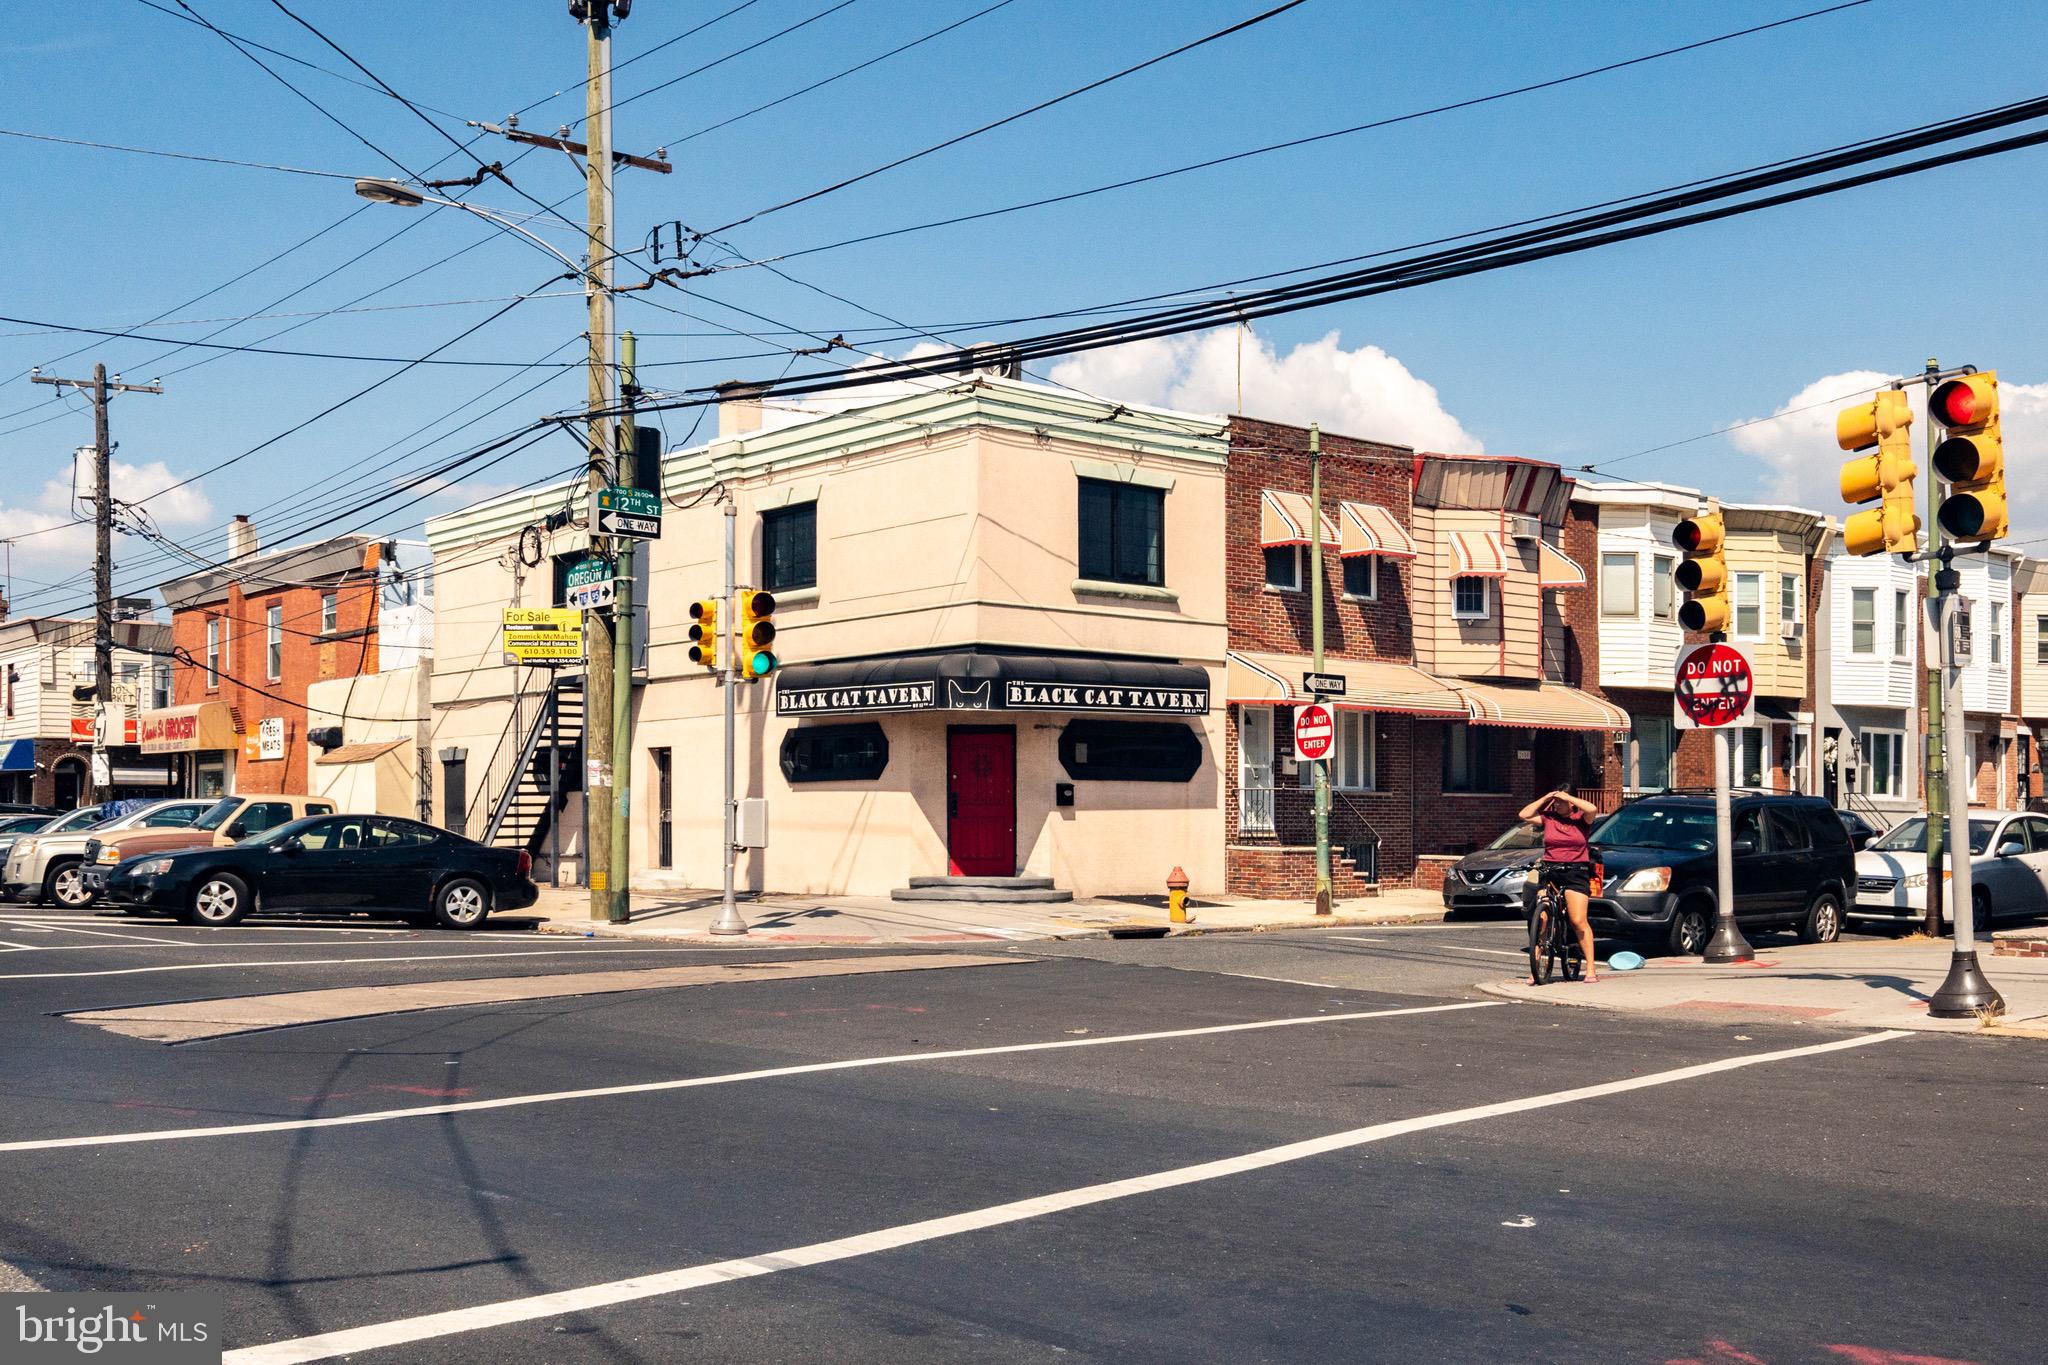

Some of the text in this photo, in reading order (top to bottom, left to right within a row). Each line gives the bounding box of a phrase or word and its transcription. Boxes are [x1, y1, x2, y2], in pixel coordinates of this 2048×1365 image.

[614, 497, 659, 515] 12TH ST
[617, 518, 655, 532] ONE WAY
[568, 569, 602, 587] OREGON
[506, 611, 551, 622] For Sale
[1687, 659, 1742, 675] DO NOT
[1315, 680, 1342, 690] ONE WAY
[780, 686, 932, 710] BLACK CAT TAVERN
[1009, 686, 1206, 709] BLACK CAT TAVERN
[164, 714, 198, 741] GROCERY
[1300, 714, 1328, 727] DO NOT
[262, 739, 281, 751] MEATS
[1303, 738, 1326, 750] ENTER
